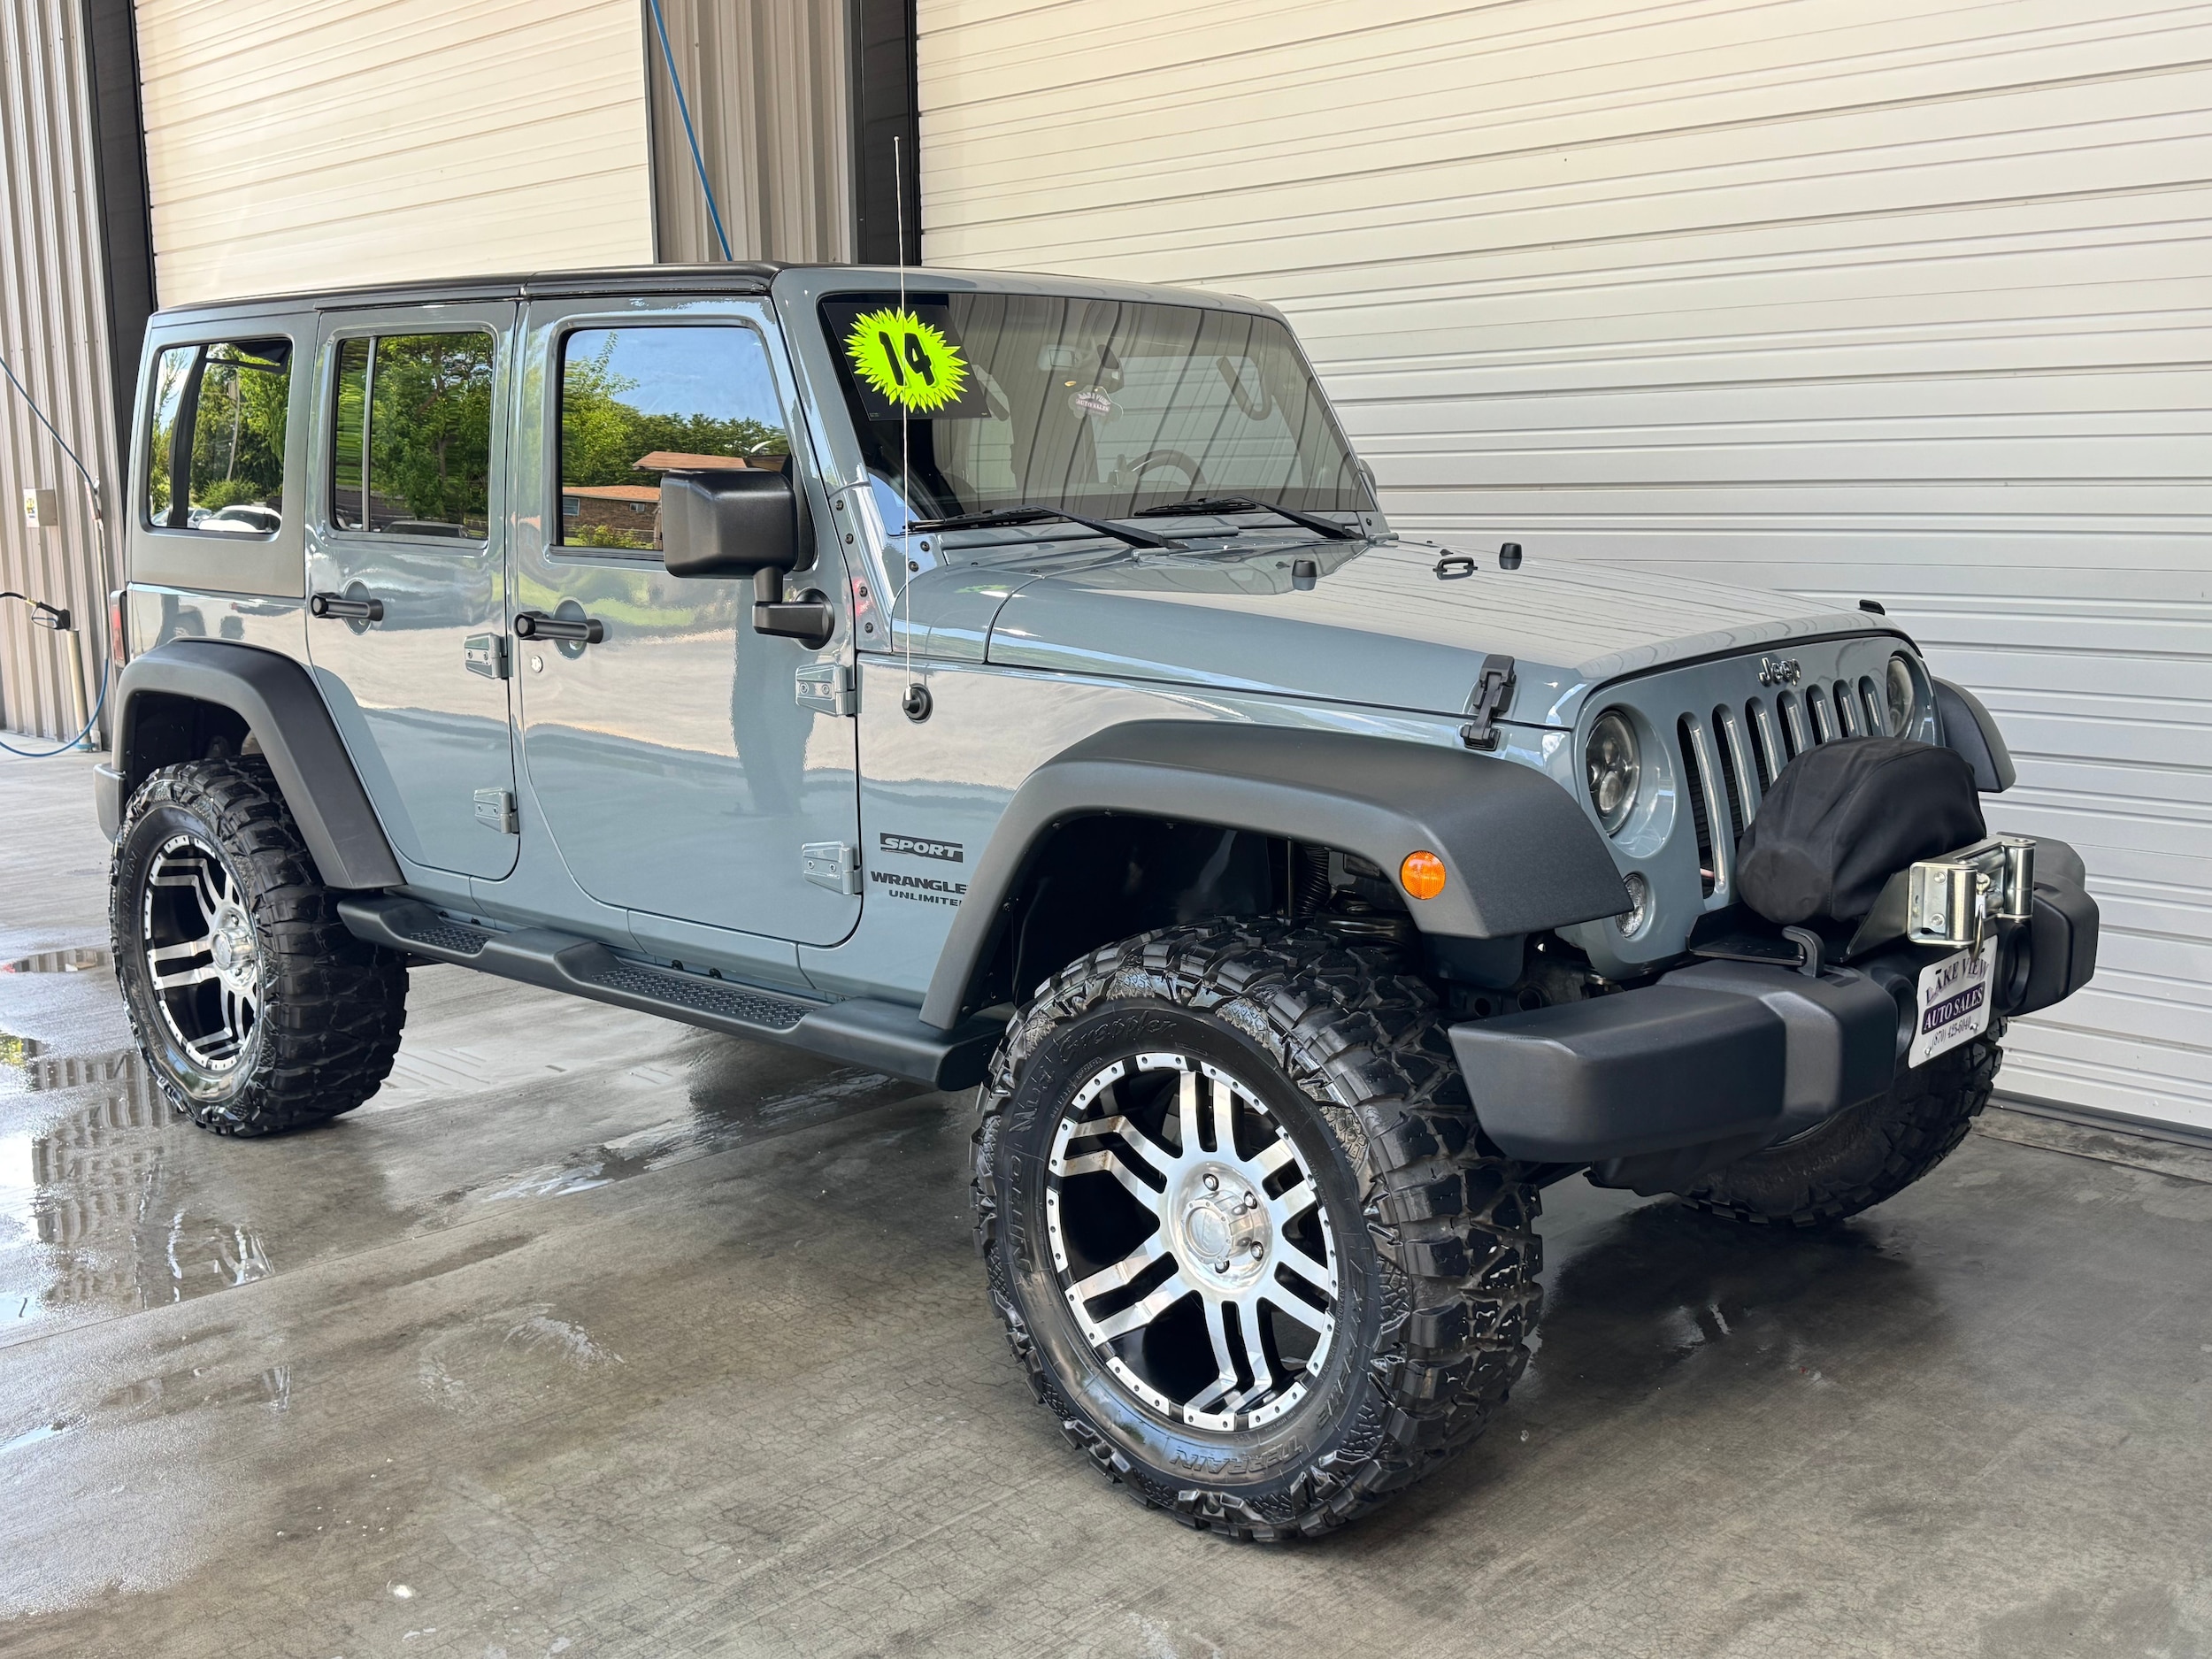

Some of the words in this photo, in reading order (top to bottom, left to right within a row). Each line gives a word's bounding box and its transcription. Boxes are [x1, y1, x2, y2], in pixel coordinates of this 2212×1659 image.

[879, 331, 937, 387] 14
[1758, 657, 1801, 687] Jeep
[884, 837, 963, 858] SPORT
[871, 871, 968, 895] WRANGLE
[1926, 961, 1959, 1006] LAKE
[1962, 957, 1989, 981] VIEW
[1924, 1002, 1953, 1031] AUTO
[1953, 987, 1983, 1016] SALES
[1009, 1154, 1033, 1273] NITTO
[1059, 1010, 1179, 1064] Grappler
[1170, 1434, 1304, 1475] TERRAIN
